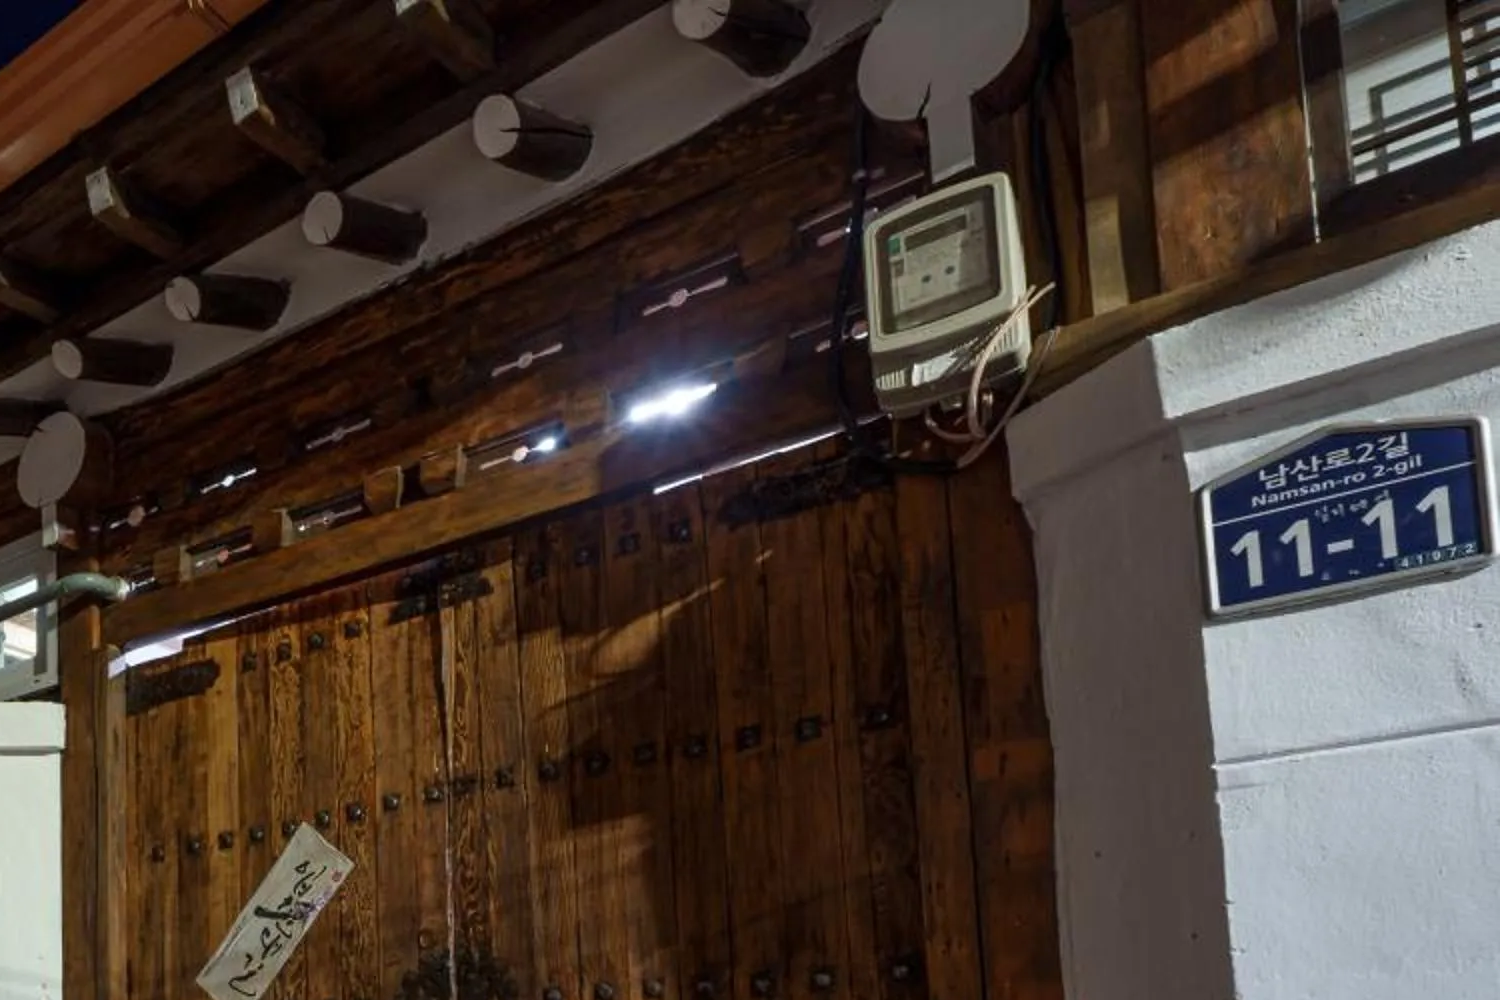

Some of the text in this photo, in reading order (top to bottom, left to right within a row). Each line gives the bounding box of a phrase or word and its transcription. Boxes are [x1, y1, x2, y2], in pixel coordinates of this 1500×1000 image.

[1250, 471, 1367, 508] Namsan-ro
[1371, 453, 1423, 479] 2-gil
[1258, 431, 1410, 491] 남산로2길
[1229, 485, 1454, 588] 11-11
